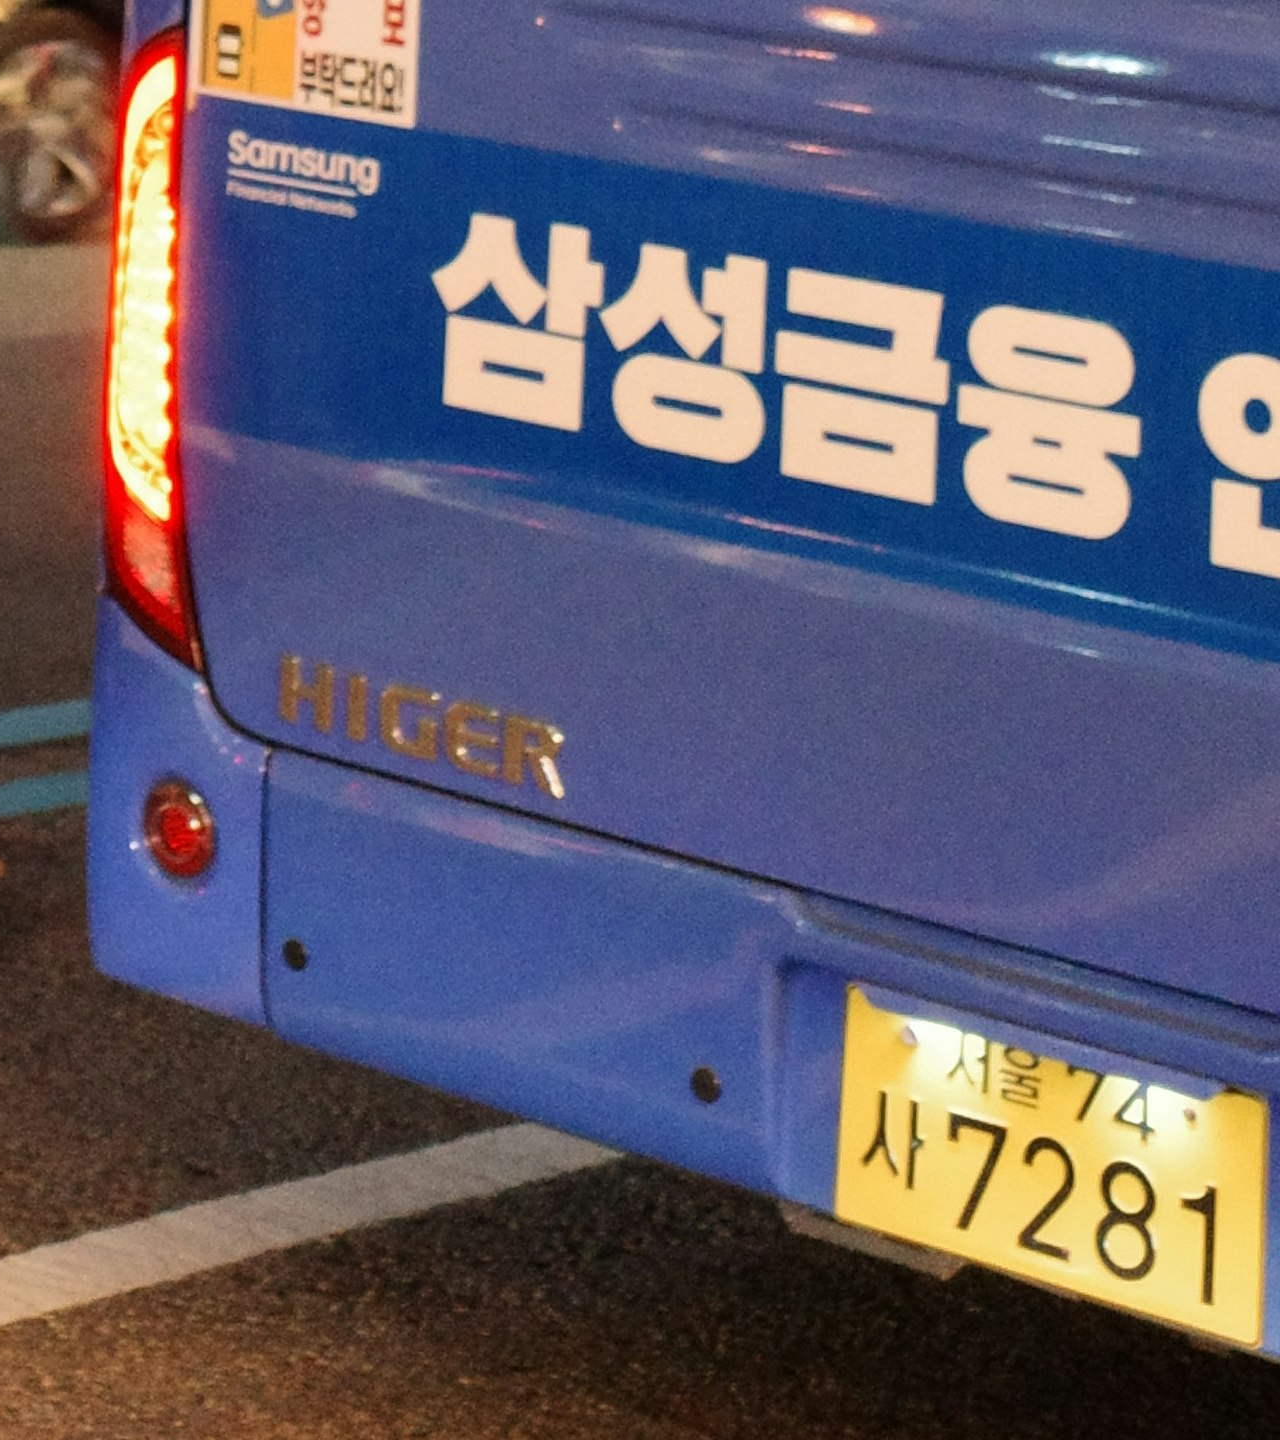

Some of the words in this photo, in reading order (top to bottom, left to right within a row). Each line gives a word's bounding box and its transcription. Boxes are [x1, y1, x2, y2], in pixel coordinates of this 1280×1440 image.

[228, 131, 381, 197] Samsung
[431, 212, 1143, 541] 삼성금융
[279, 652, 566, 799] HIGER
[947, 1031, 1041, 1109] 서울
[1067, 1061, 1155, 1142] 74
